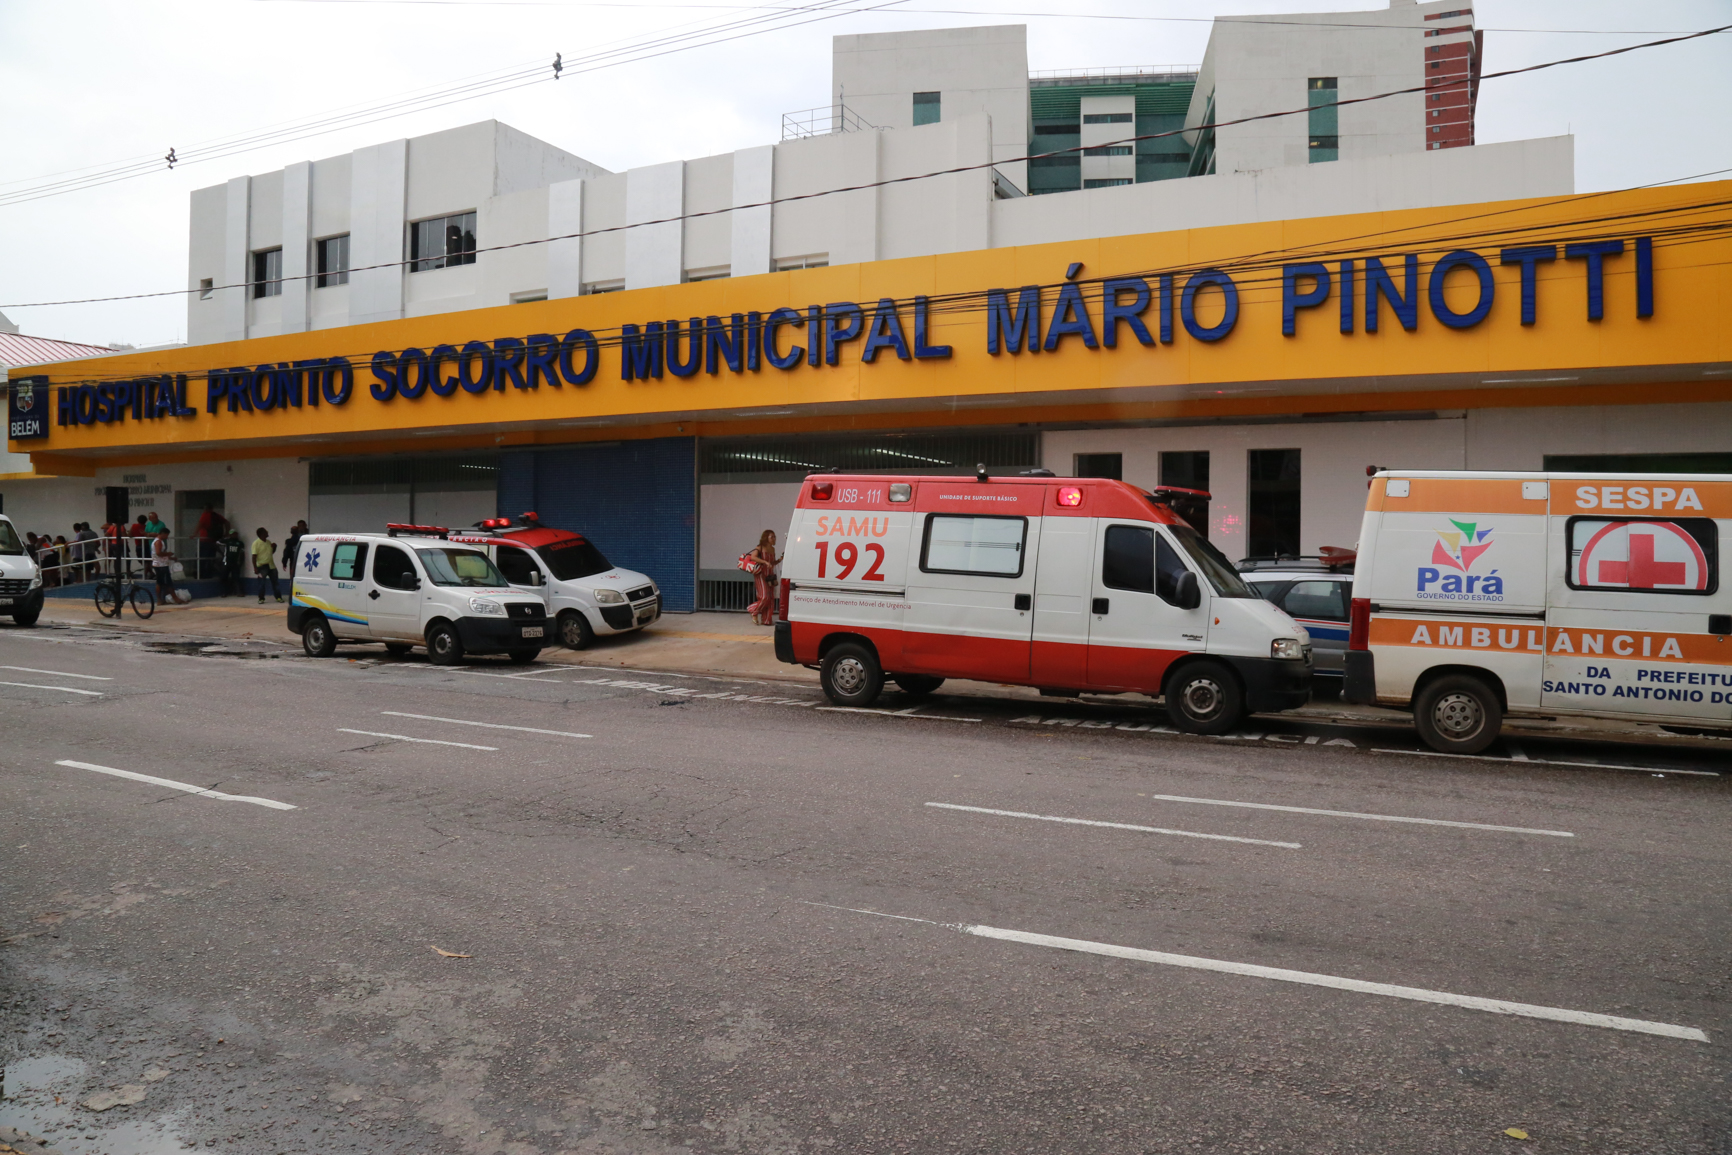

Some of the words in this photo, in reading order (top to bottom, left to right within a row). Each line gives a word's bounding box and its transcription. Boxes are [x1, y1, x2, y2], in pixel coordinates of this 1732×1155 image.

[57, 374, 197, 427] HOSPITAL
[206, 356, 354, 414] PRONTO
[369, 328, 600, 402] SOCORRO
[621, 294, 953, 381] MUNICIPAL
[987, 262, 1240, 355] MÁRIO
[1282, 236, 1655, 337] PINOTTI
[11, 419, 40, 437] BELÉM
[837, 488, 858, 503] USB
[867, 489, 881, 504] 111
[1575, 486, 1704, 510] SESPA
[815, 516, 889, 538] SAMU
[815, 541, 885, 582] 192
[1417, 567, 1503, 595] Pará
[793, 595, 813, 604] Serviço
[822, 598, 858, 607] Atendimento
[858, 600, 877, 608] Móvel
[886, 601, 912, 610] Urgência
[1416, 592, 1456, 600] GOVERNO
[1457, 593, 1470, 601] DO
[1471, 594, 1504, 602] ESTADO
[1586, 666, 1612, 680] DA
[1637, 669, 1732, 687] PREFEITU
[1543, 680, 1607, 697] SANTO
[1612, 685, 1704, 703] ANTONIO
